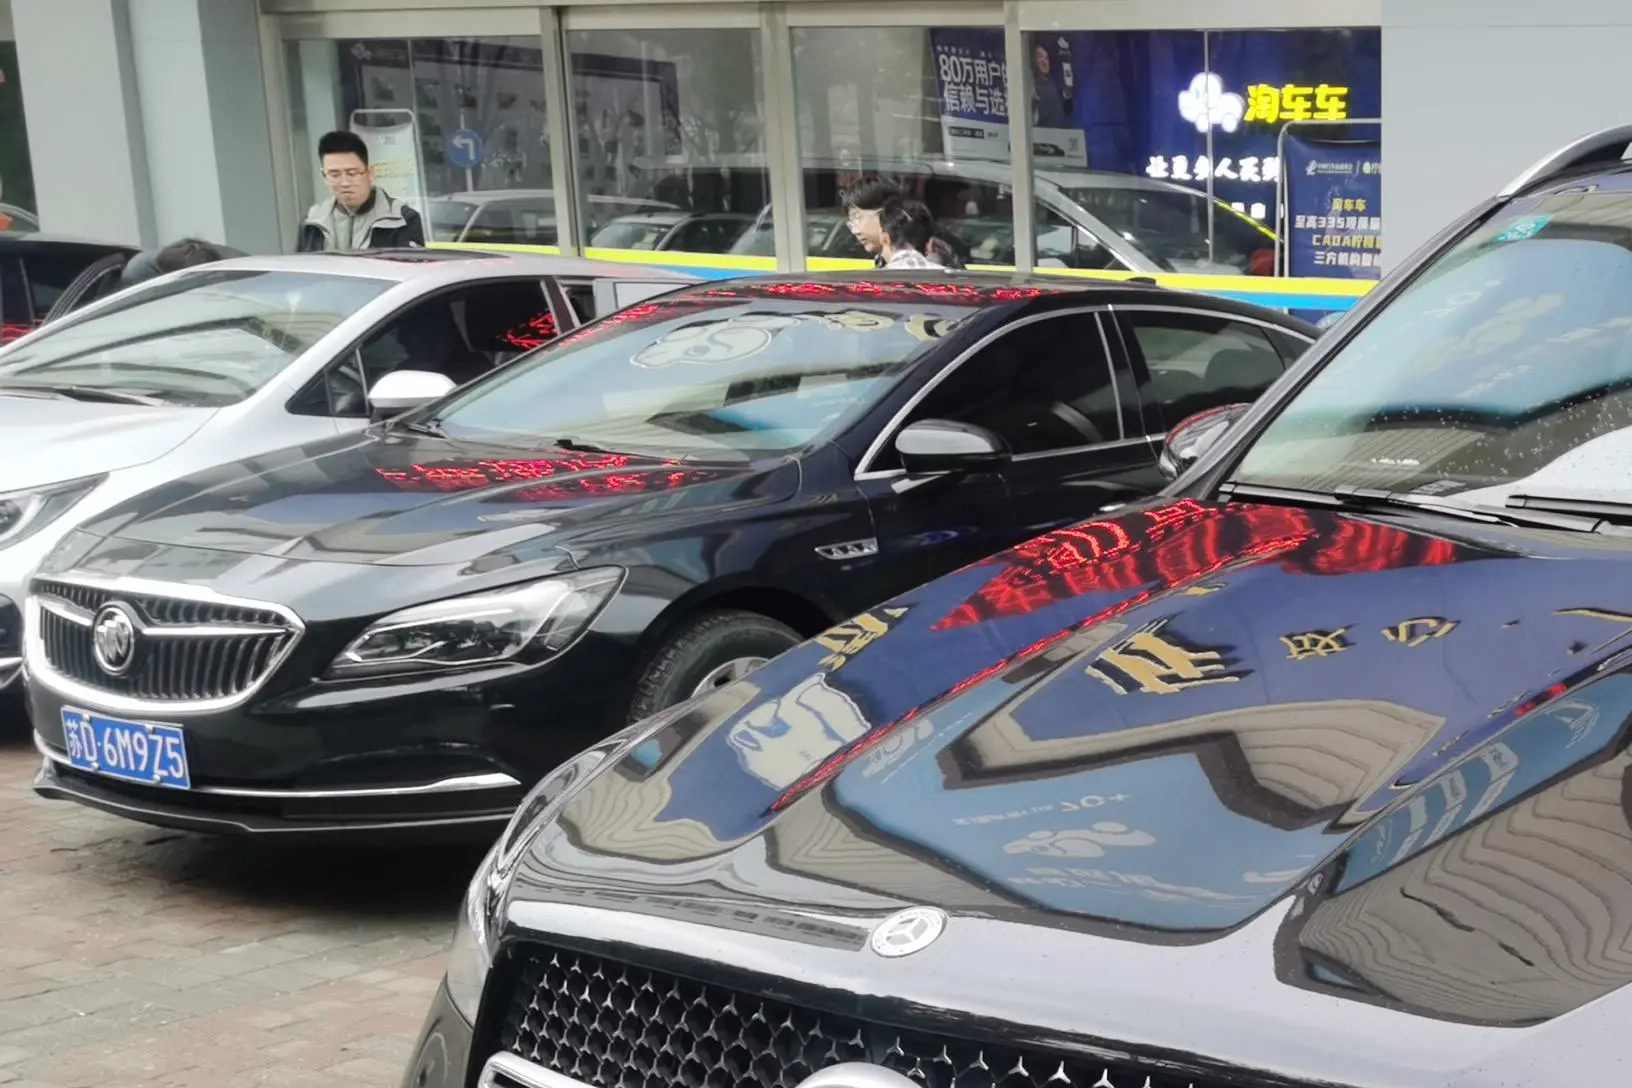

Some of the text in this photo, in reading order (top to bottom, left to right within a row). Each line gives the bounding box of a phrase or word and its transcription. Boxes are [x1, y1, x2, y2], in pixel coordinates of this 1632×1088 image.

[943, 82, 1009, 117] 信赖与选
[1244, 84, 1349, 124] 淘车车
